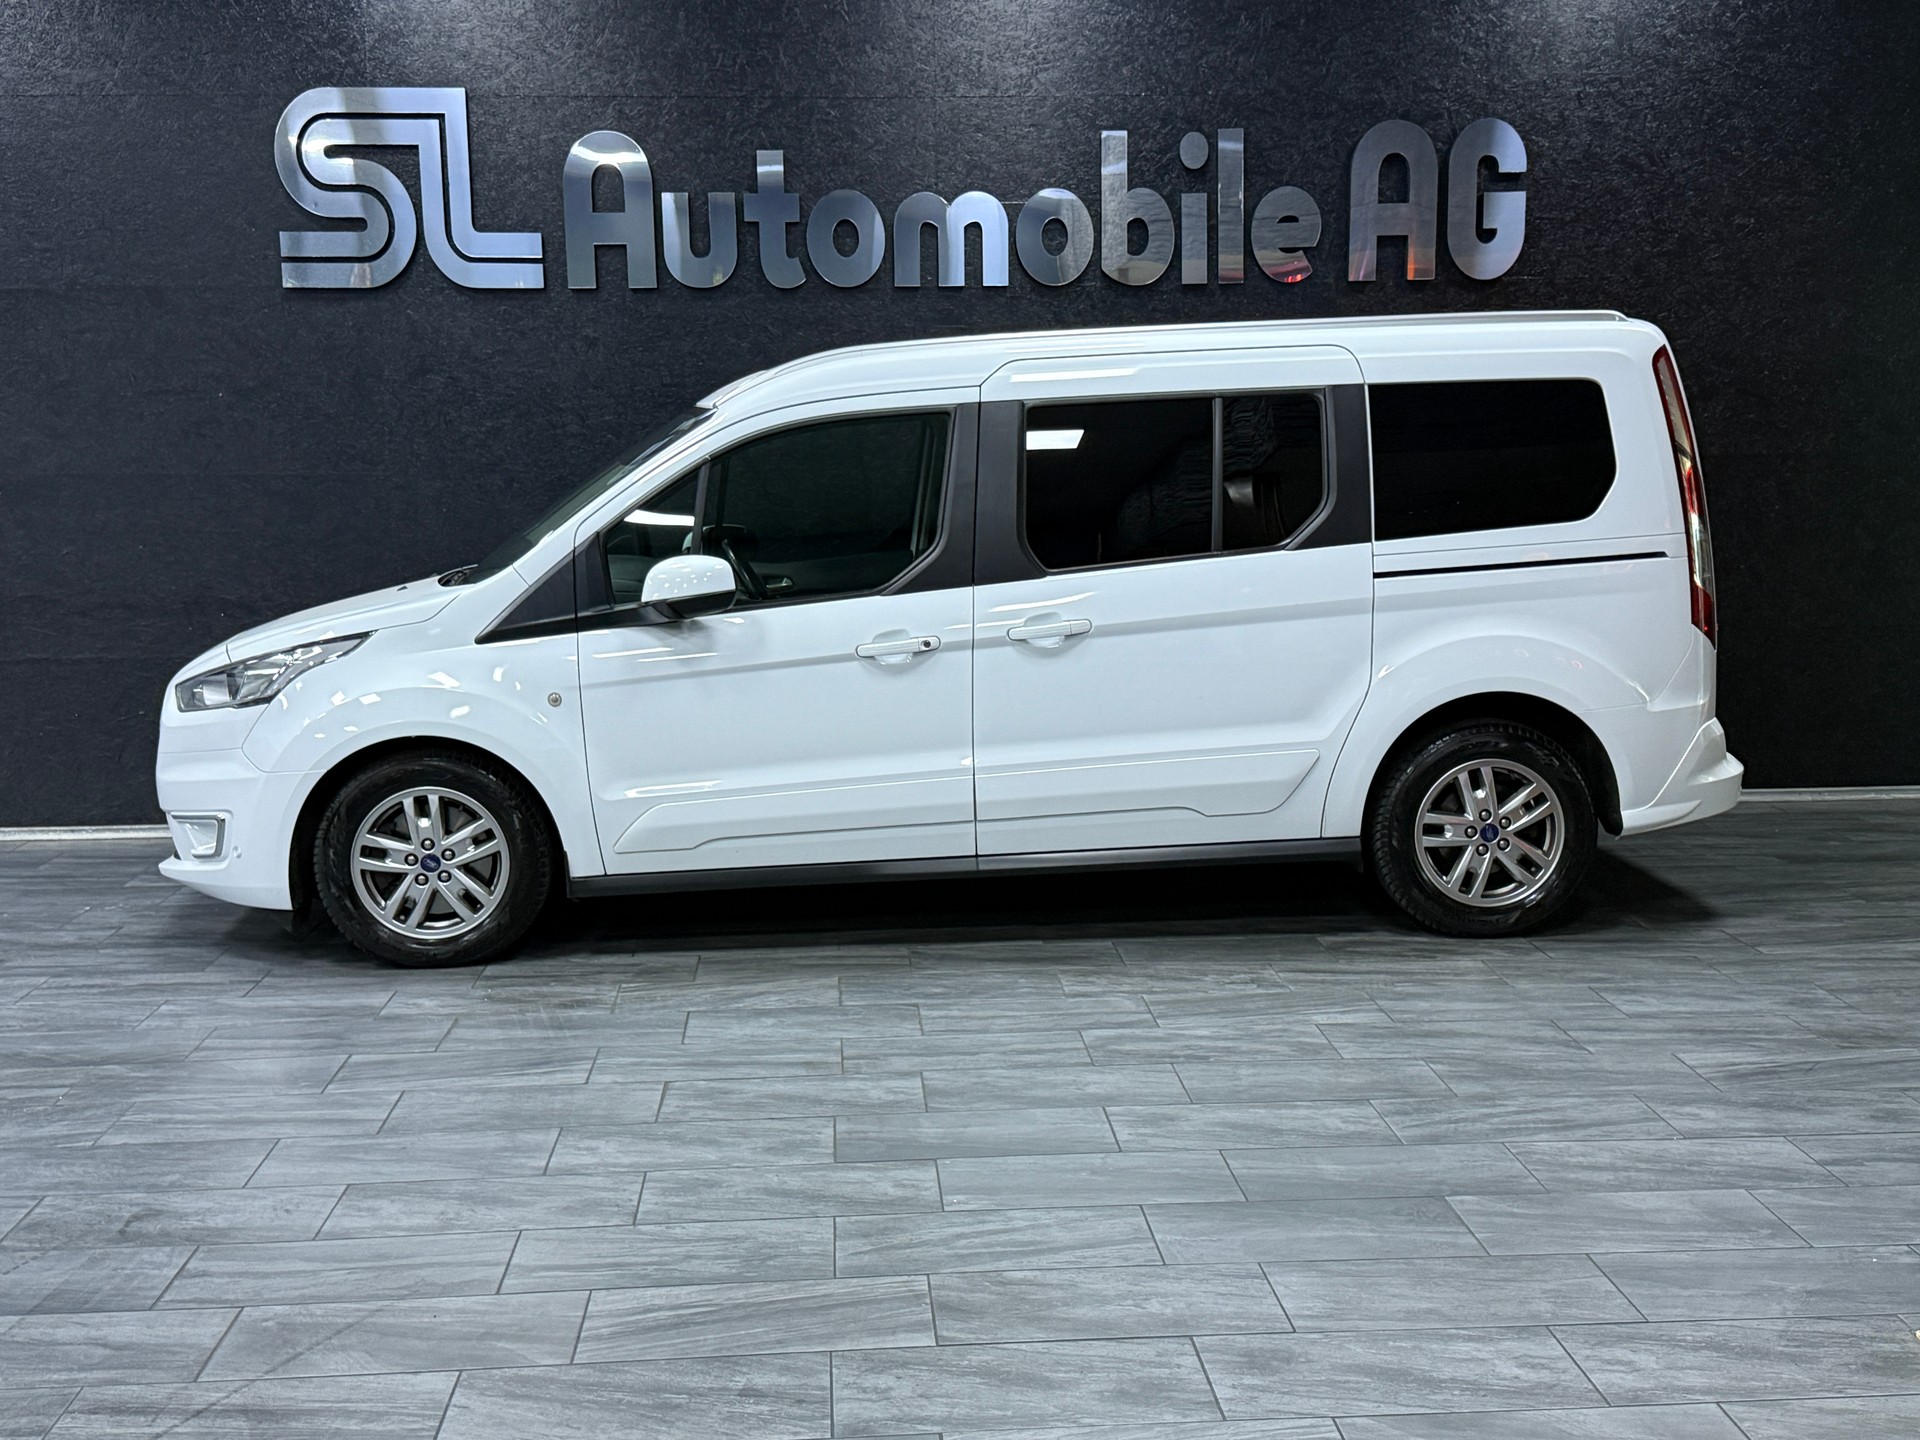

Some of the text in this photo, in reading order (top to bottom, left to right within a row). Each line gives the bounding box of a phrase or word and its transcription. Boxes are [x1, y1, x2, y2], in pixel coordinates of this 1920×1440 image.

[275, 87, 1527, 288] SL Automobile AG
